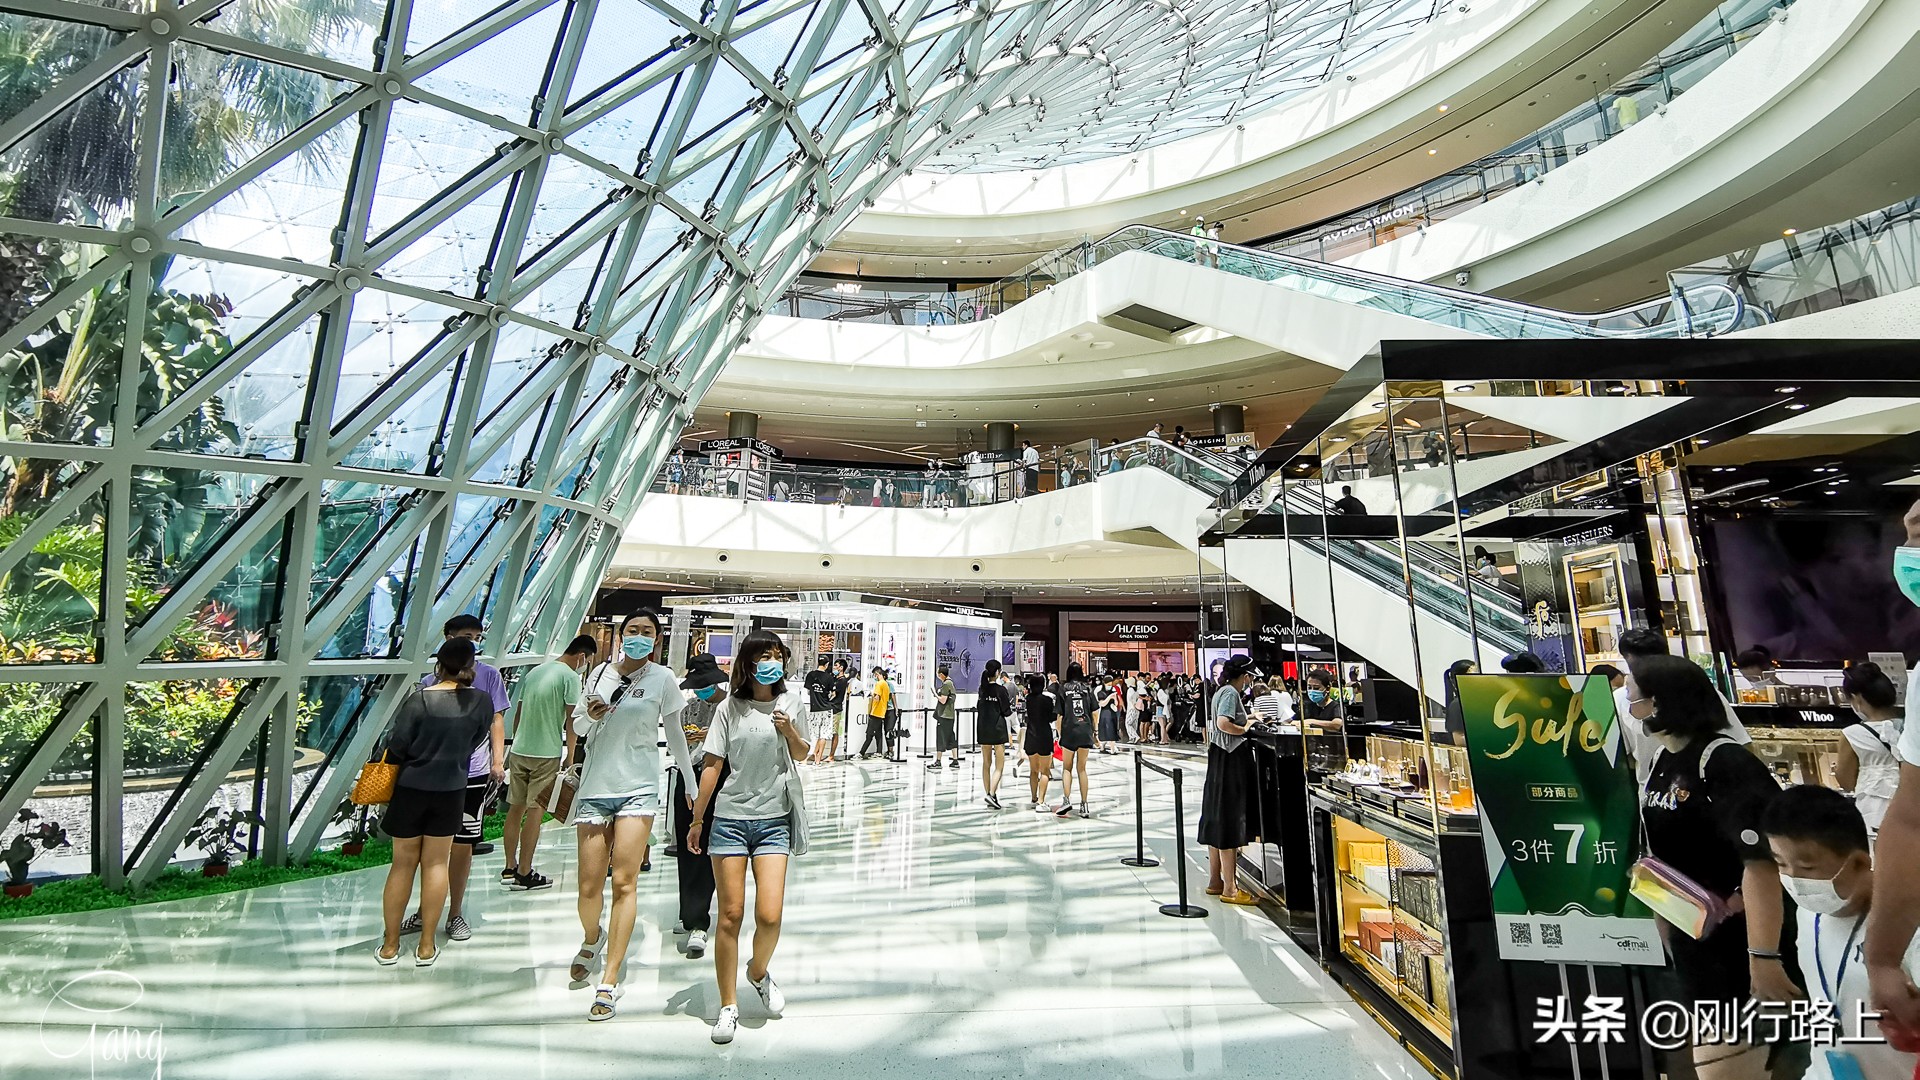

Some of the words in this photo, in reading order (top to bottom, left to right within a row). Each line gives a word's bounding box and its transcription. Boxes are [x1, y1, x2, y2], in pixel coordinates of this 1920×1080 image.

[832, 282, 863, 294] JNBY
[1192, 437, 1225, 445] ORIGINS
[1229, 435, 1251, 444] AHC
[1563, 533, 1581, 546] BEST
[1580, 525, 1613, 545] SELLERS
[727, 595, 756, 605] CLINIQUE
[1108, 623, 1158, 634] SHISEIDO
[1799, 710, 1835, 722] Whoo
[1483, 688, 1606, 760] Sale
[1531, 786, 1579, 799] 部分商品
